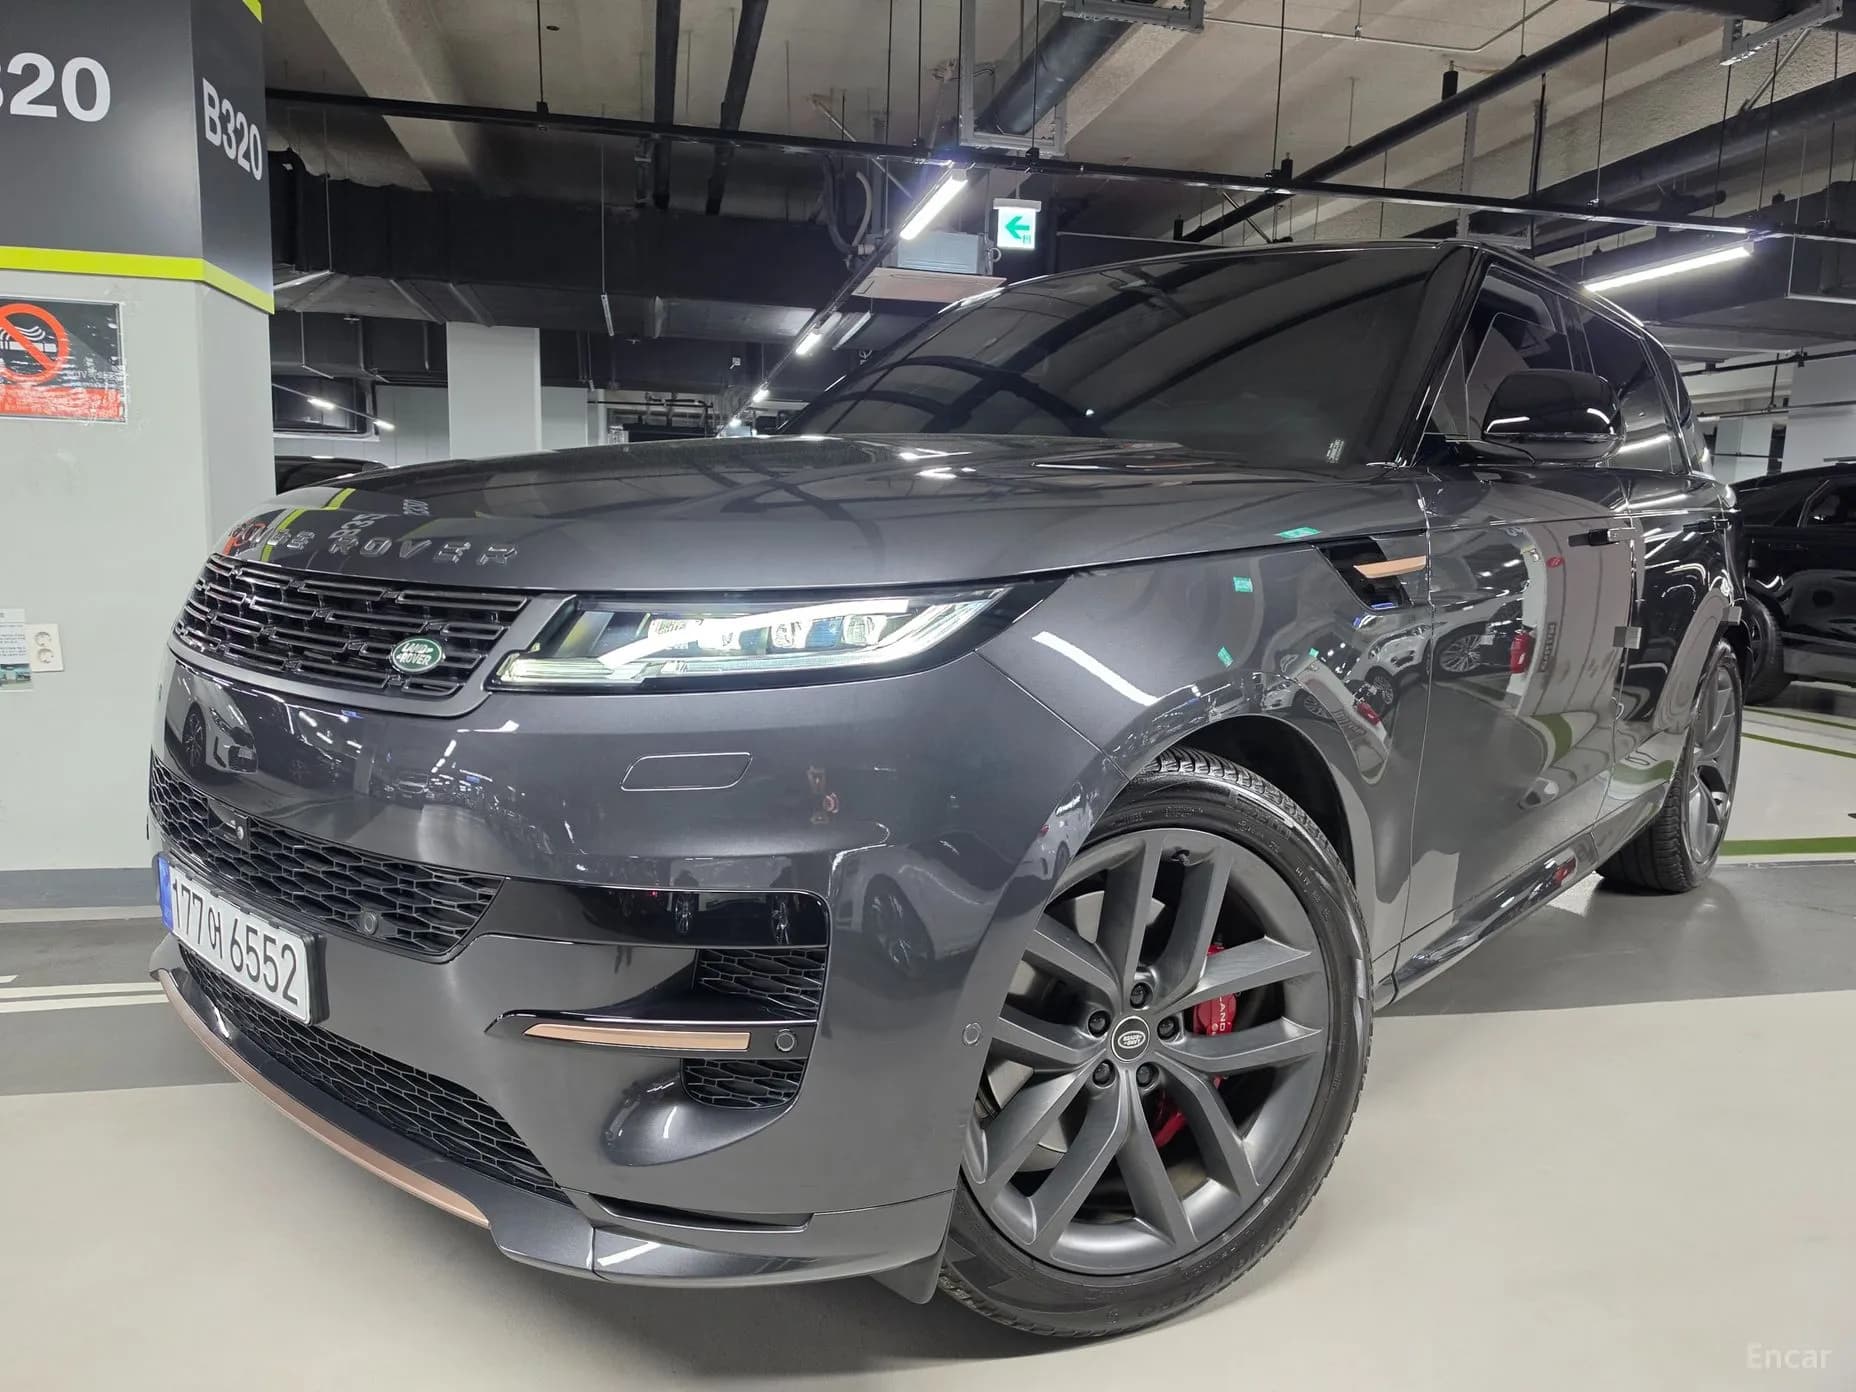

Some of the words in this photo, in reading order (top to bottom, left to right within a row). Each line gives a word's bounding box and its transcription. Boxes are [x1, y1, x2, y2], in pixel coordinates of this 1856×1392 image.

[0, 52, 111, 122] 20
[202, 77, 263, 181] B320
[400, 653, 432, 665] ROVER
[401, 642, 428, 653] LAND
[172, 879, 223, 959] 177어
[230, 918, 298, 1006] 6552
